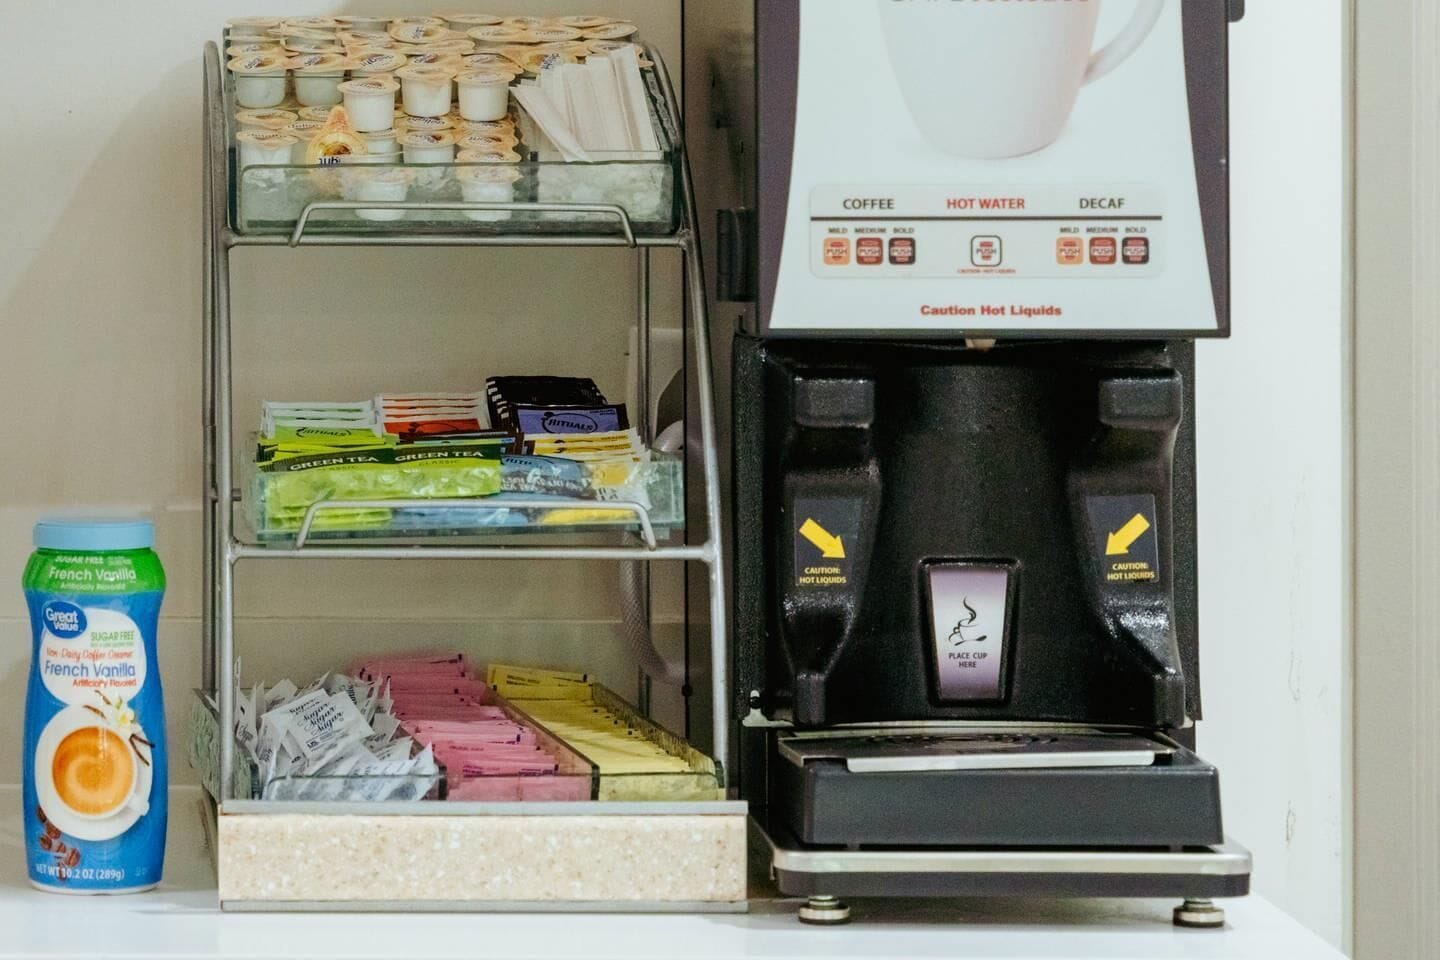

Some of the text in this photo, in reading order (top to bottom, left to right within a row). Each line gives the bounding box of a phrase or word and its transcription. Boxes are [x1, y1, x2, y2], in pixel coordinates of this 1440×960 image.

[843, 198, 895, 210] COFFEE
[947, 198, 1025, 209] HOT WATER
[1079, 198, 1125, 209] DECAF
[826, 247, 848, 256] PUSH
[859, 247, 882, 256] PUSH
[892, 247, 914, 256] PUSH
[1060, 247, 1080, 256] PUSH
[1092, 247, 1114, 256] PUSH
[1124, 247, 1147, 256] PUSH
[920, 304, 1063, 318] Caution Hot Liquids
[547, 418, 593, 431] RITUALS
[394, 450, 484, 463] GREEN TEA
[290, 455, 379, 472] GREEN TEA
[48, 566, 137, 581] French Vanilla
[804, 567, 841, 575] CAUTION:
[1107, 570, 1155, 581] HOT LIQUIDS
[800, 576, 847, 585] HOT LIQUIDS
[46, 607, 78, 624] Great
[54, 622, 79, 631] Value
[91, 630, 135, 641] SUGAR FREE
[948, 652, 988, 660] PLACE CUP
[44, 660, 136, 678] French Vanilla
[48, 865, 60, 877] WT
[82, 868, 94, 879] OZ
[95, 869, 125, 881] (289g)
